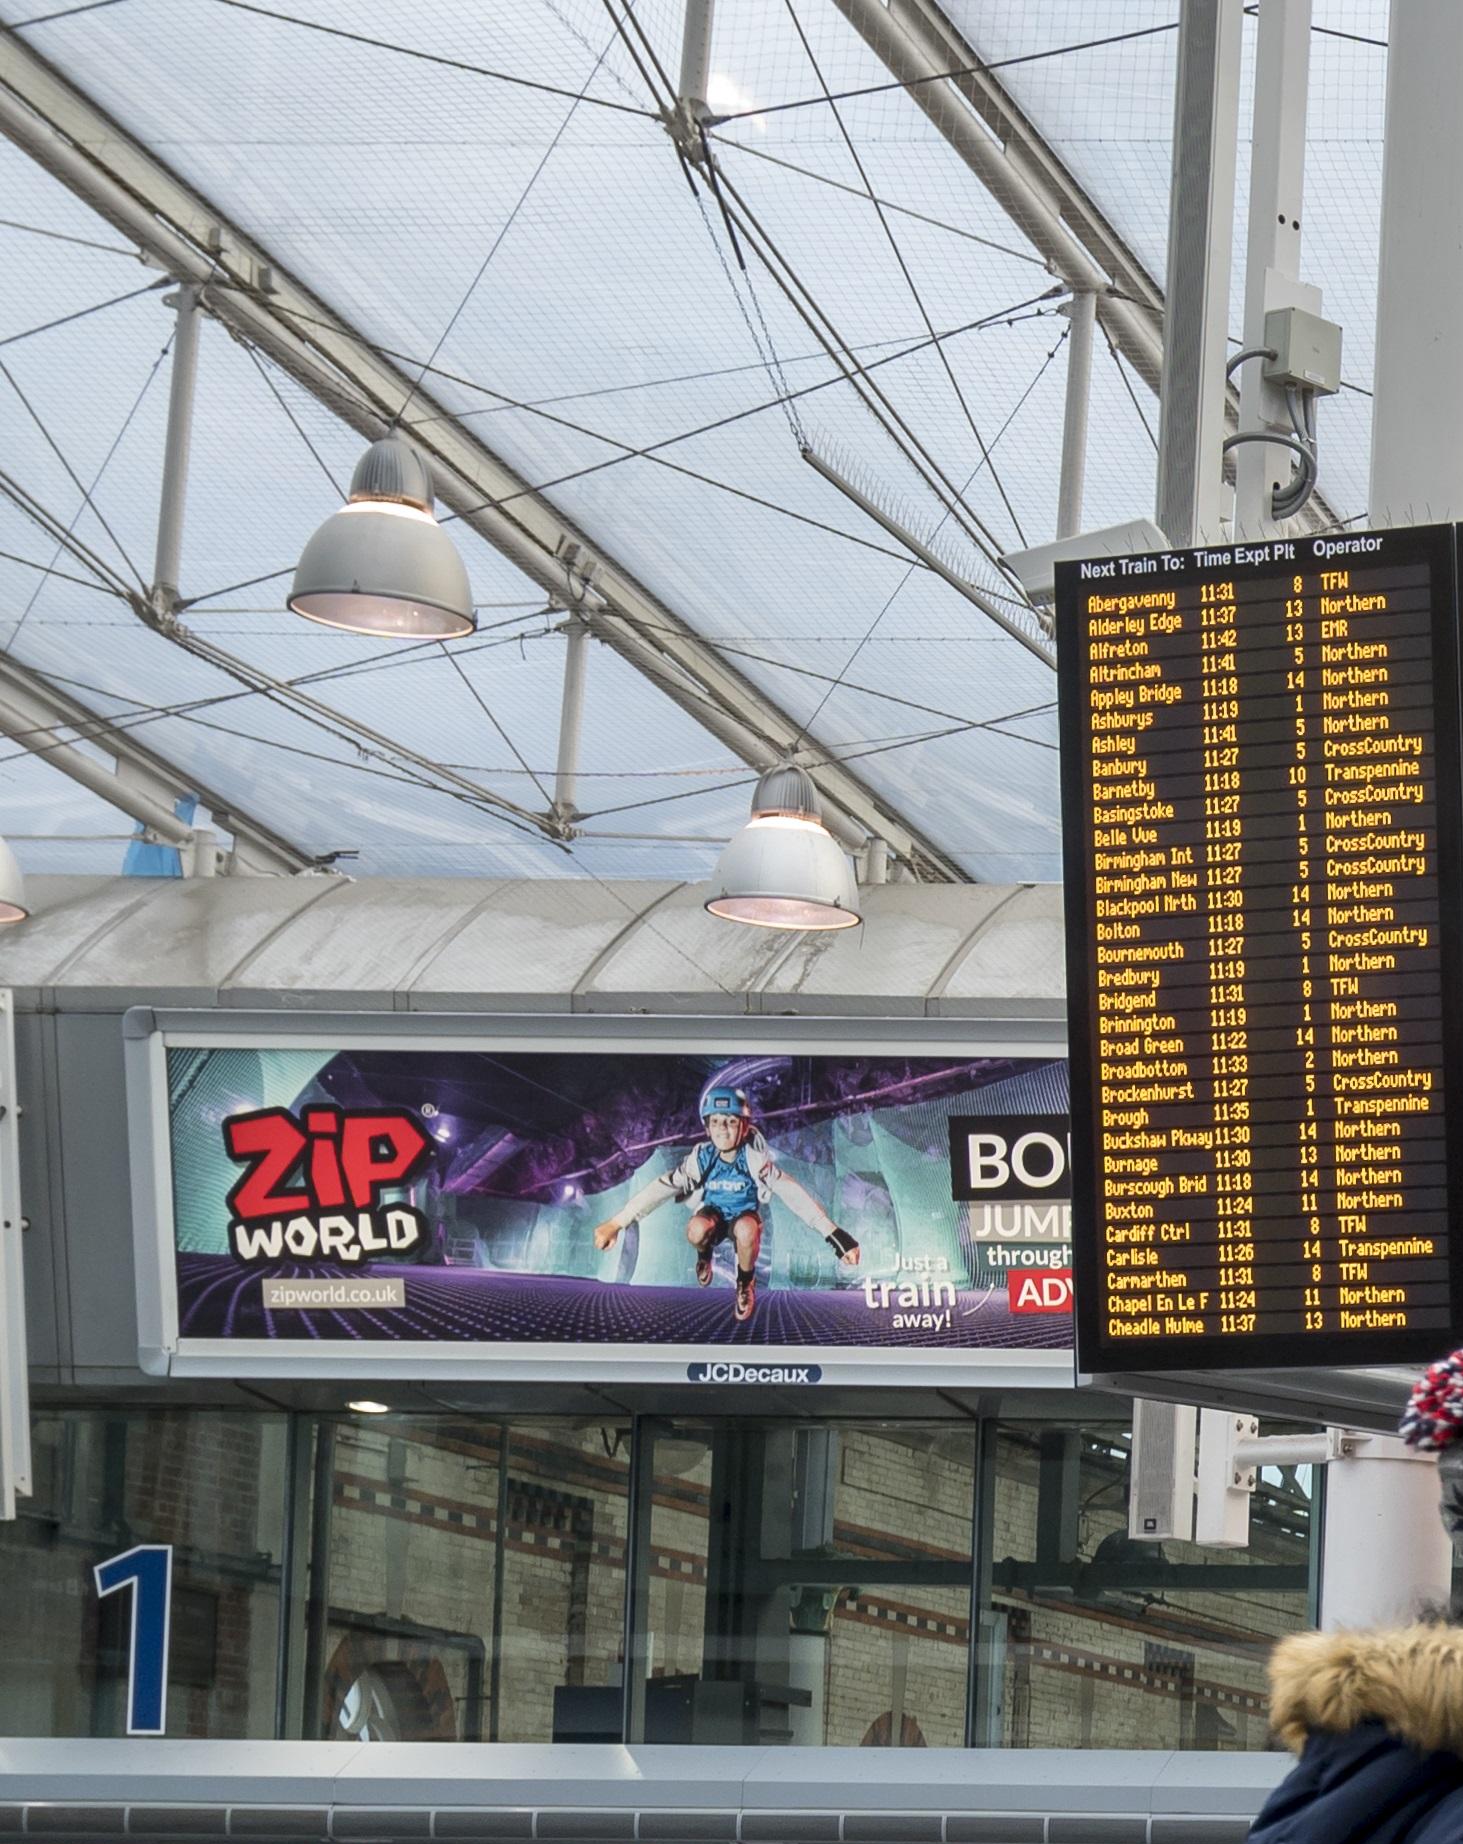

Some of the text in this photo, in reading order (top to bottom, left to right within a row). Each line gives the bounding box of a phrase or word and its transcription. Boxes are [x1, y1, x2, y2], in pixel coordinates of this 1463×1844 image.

[1087, 570, 1349, 615] Abergavenny 11:31 8 TFW
[235, 1210, 418, 1260] WORLD
[892, 1252, 947, 1271] Just a
[271, 1286, 397, 1304] zipworld.co.uk
[863, 1272, 956, 1308] train
[892, 1309, 951, 1332] away!
[699, 1364, 810, 1384] JCDecaux
[94, 1545, 172, 1734] 1
